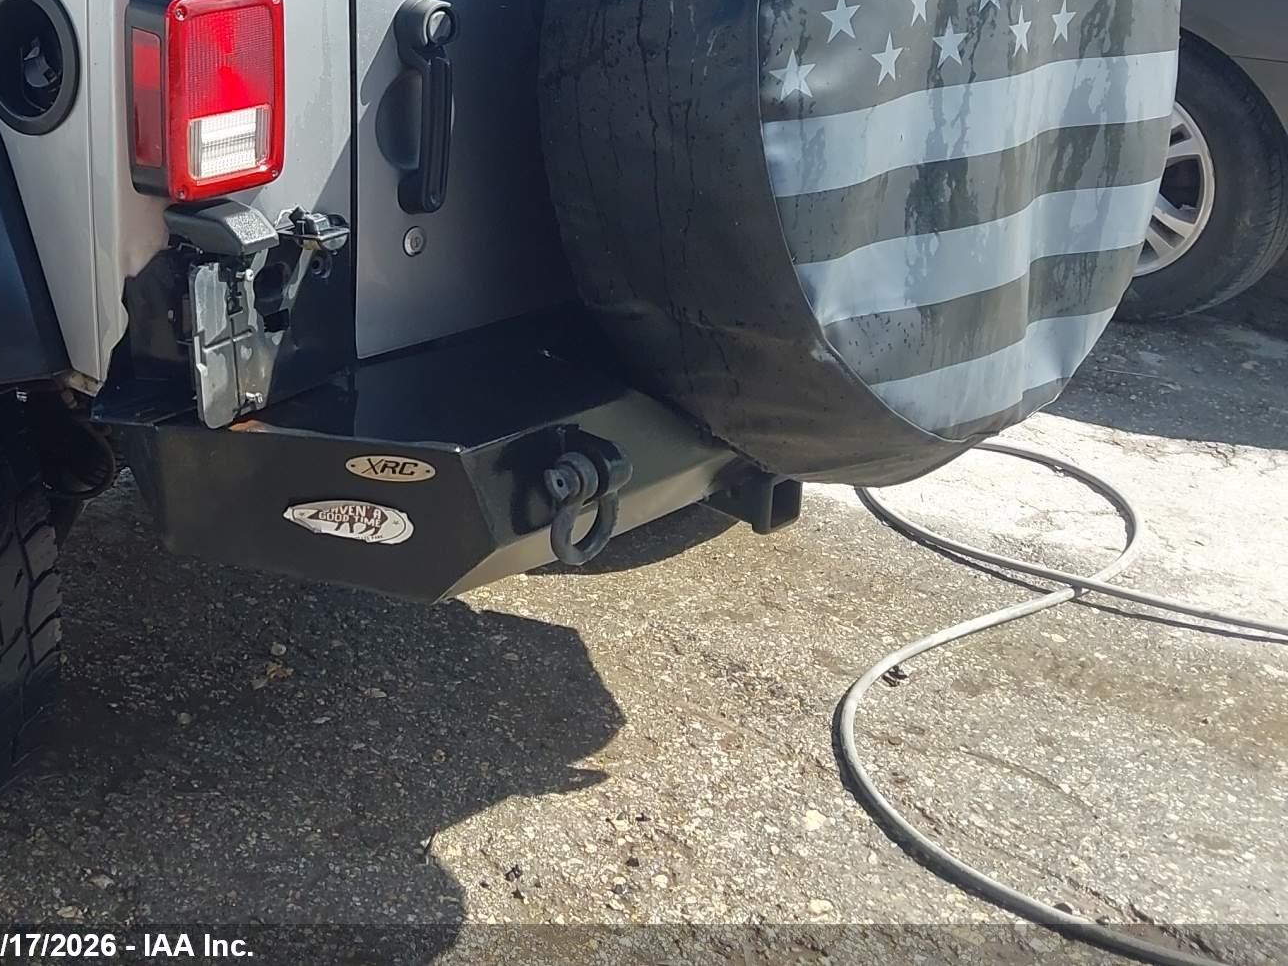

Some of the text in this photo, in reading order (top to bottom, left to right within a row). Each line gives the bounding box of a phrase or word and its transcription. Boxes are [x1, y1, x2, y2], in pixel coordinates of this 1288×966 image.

[361, 457, 419, 476] XRC
[318, 511, 382, 528] GOOD TIME
